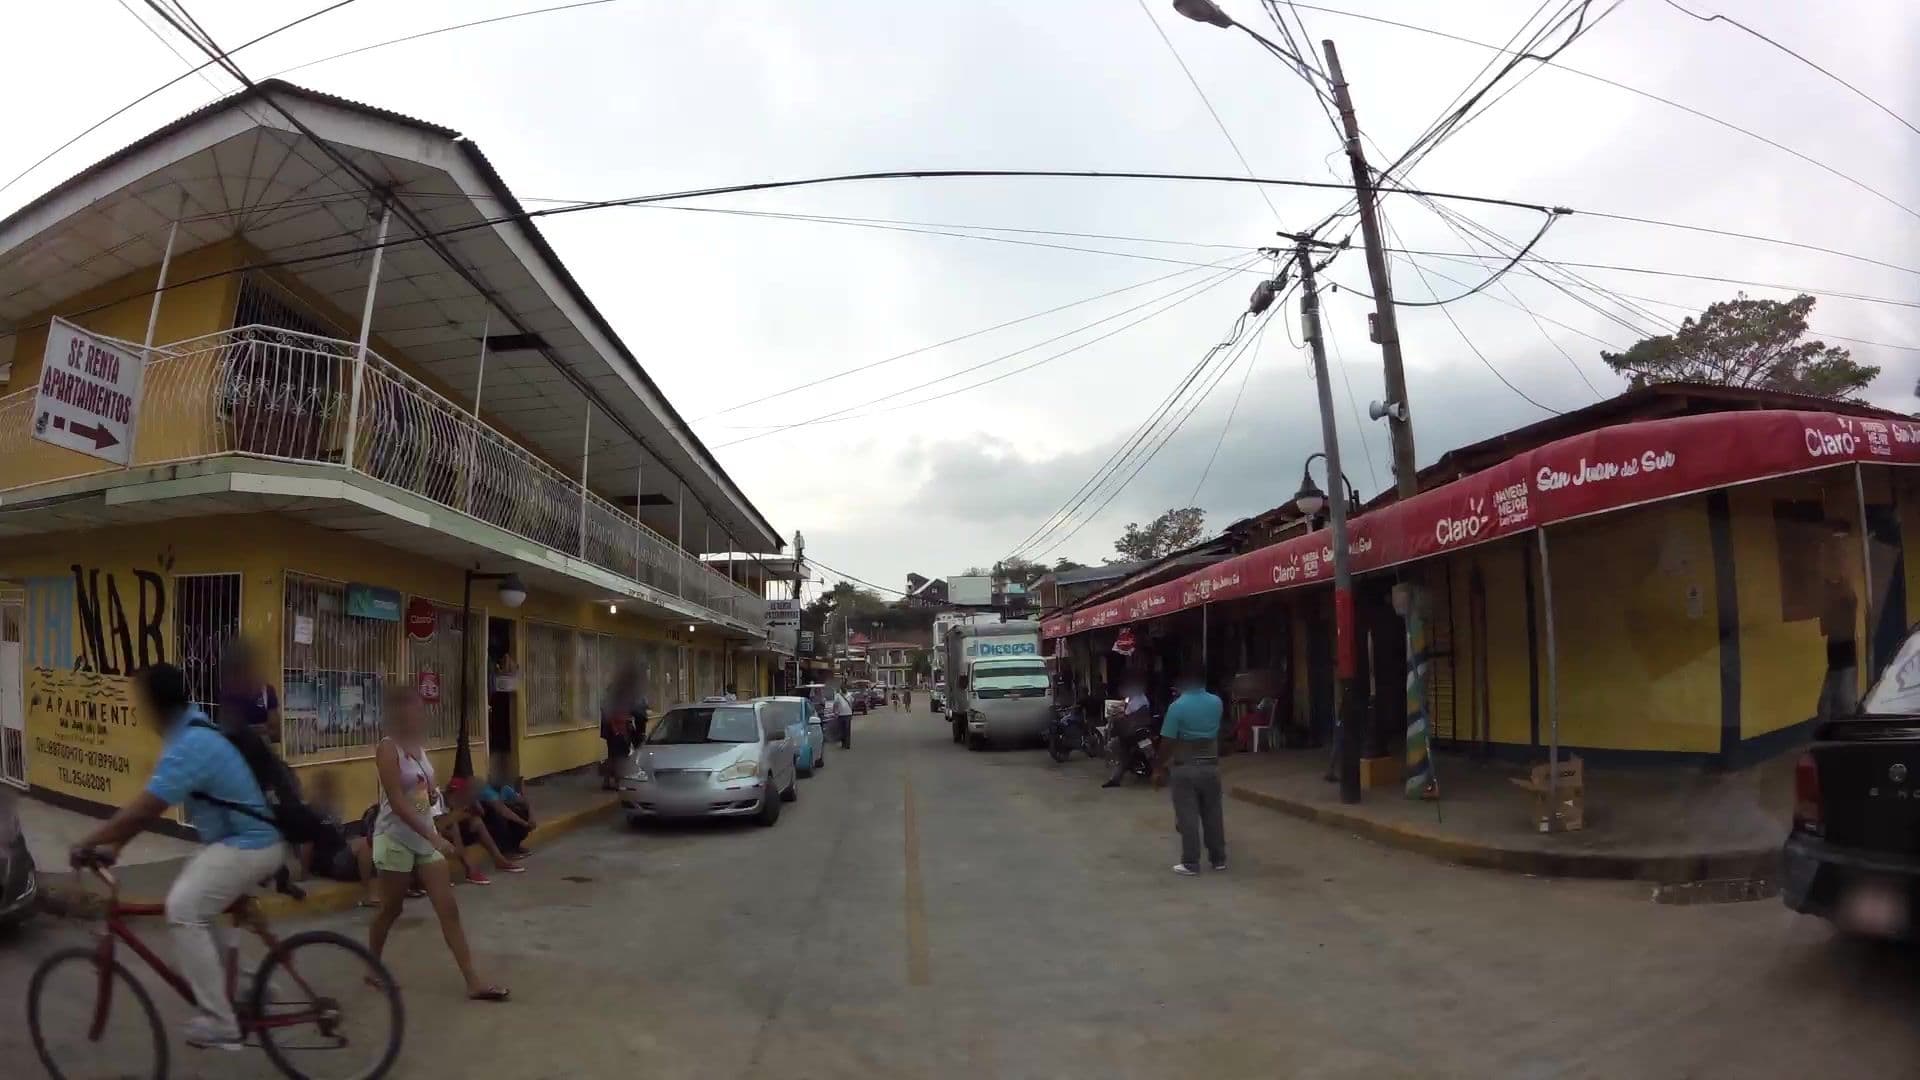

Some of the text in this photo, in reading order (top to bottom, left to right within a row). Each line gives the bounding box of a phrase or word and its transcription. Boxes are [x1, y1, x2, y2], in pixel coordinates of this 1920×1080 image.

[67, 336, 120, 385] SE RENTA
[42, 365, 132, 425] APARTAMENTOS
[1805, 428, 1855, 456] Claro
[1536, 450, 1675, 491] San Juan del Sur
[1436, 512, 1481, 545] Claro
[1273, 564, 1296, 584] Claro
[46, 695, 137, 727] APARTMENTS
